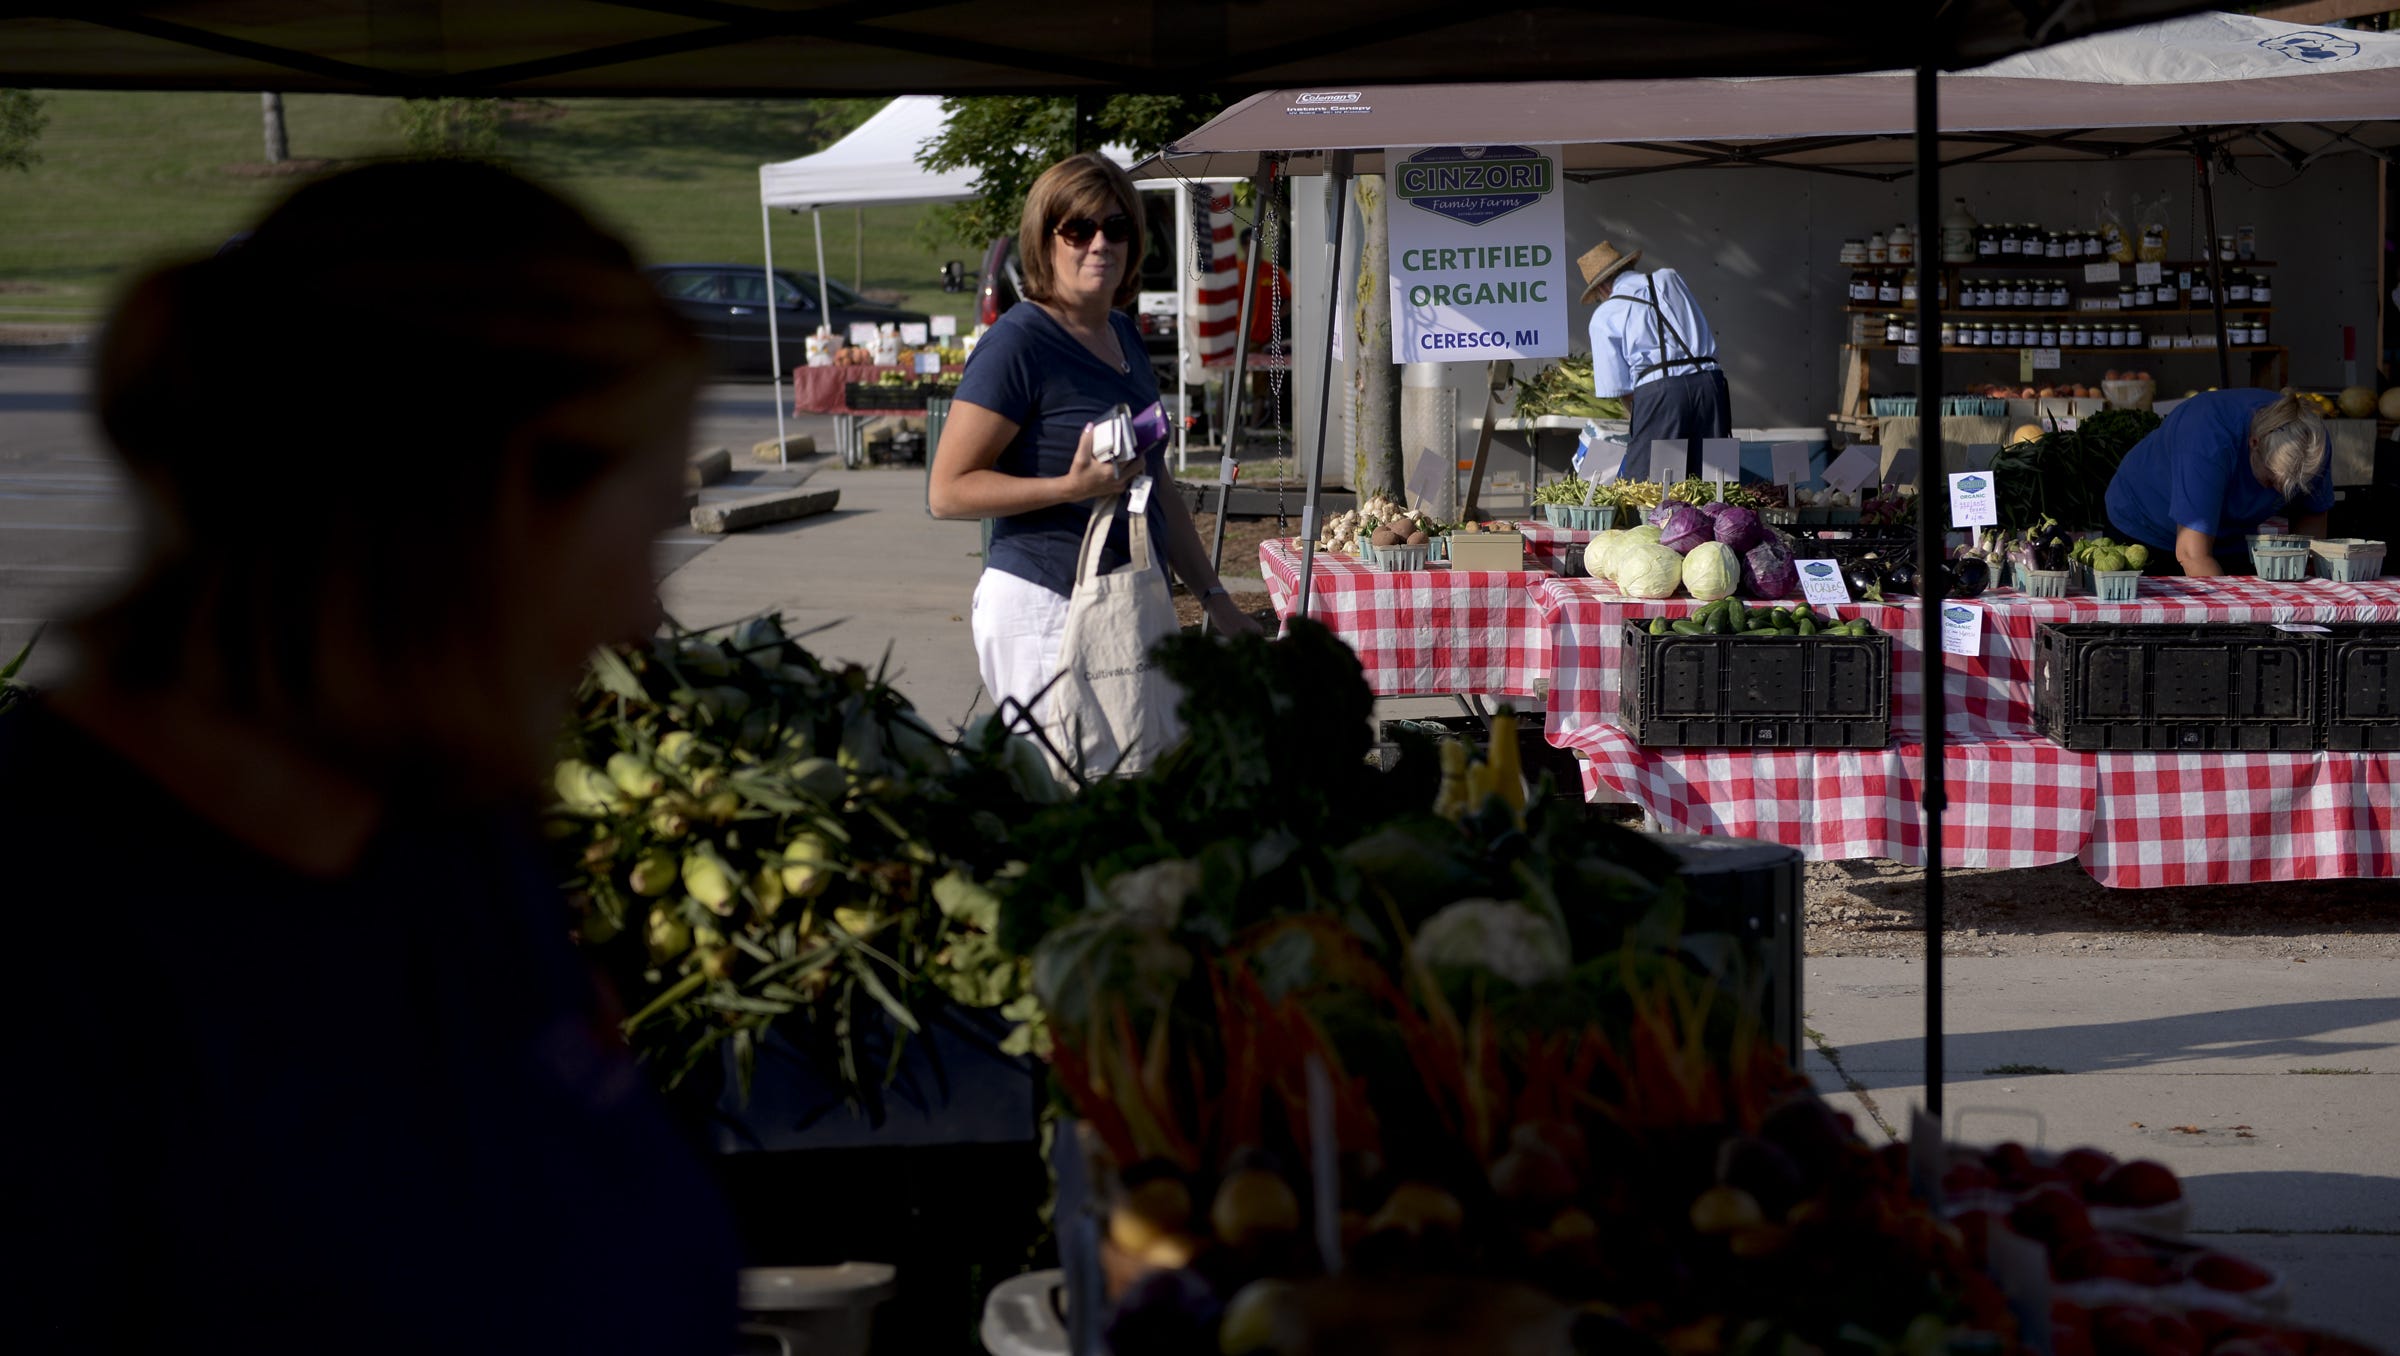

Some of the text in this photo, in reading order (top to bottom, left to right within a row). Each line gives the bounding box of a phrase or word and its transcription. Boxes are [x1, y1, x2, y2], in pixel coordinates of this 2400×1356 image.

[1302, 94, 1346, 102] Coleman
[1404, 164, 1543, 192] CINZORI
[1433, 198, 1521, 211] Family Farms
[1402, 245, 1552, 271] CERTIFIED
[1409, 280, 1548, 307] ORGANIC
[1421, 330, 1539, 350] CERESCO, MI
[1945, 622, 1972, 630] ORGANIC
